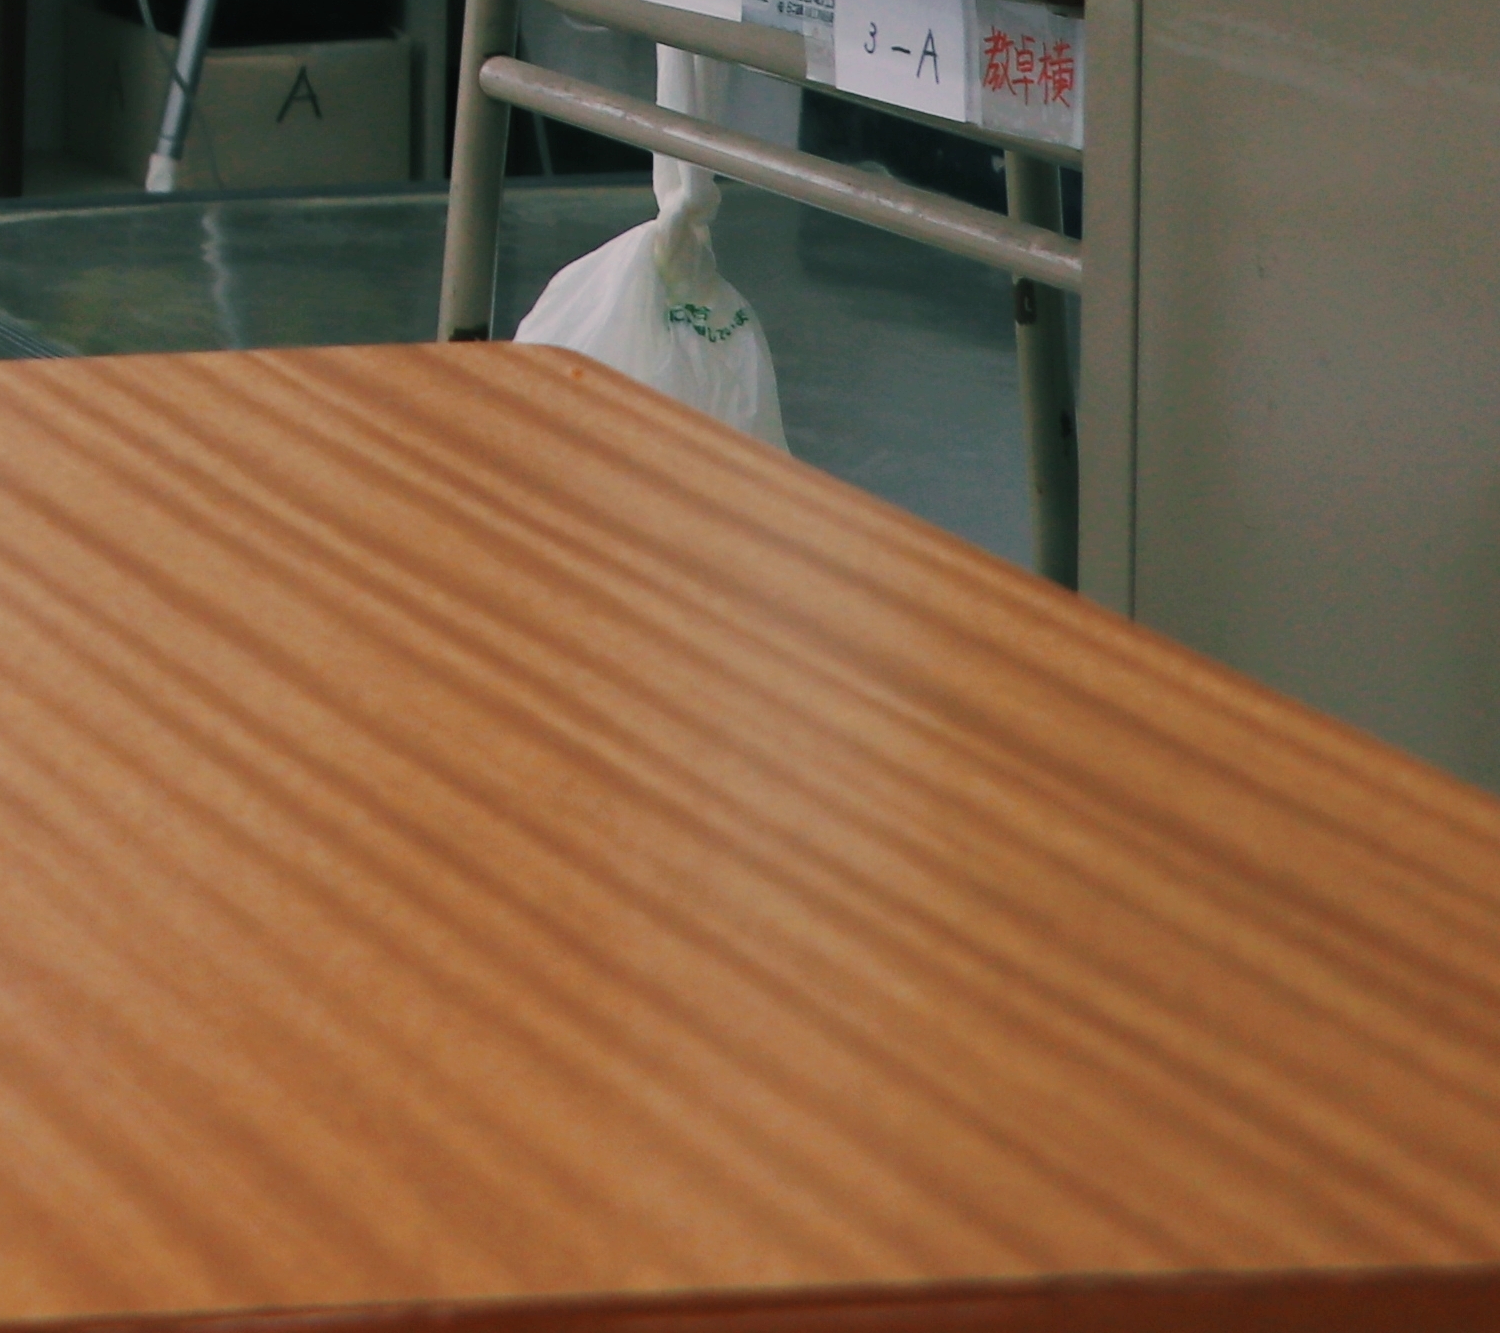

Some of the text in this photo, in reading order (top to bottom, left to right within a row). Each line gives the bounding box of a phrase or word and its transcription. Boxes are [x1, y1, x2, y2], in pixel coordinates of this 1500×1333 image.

[864, 21, 940, 84] 3-A
[982, 25, 1075, 109] 教卓横
[276, 65, 322, 123] A
